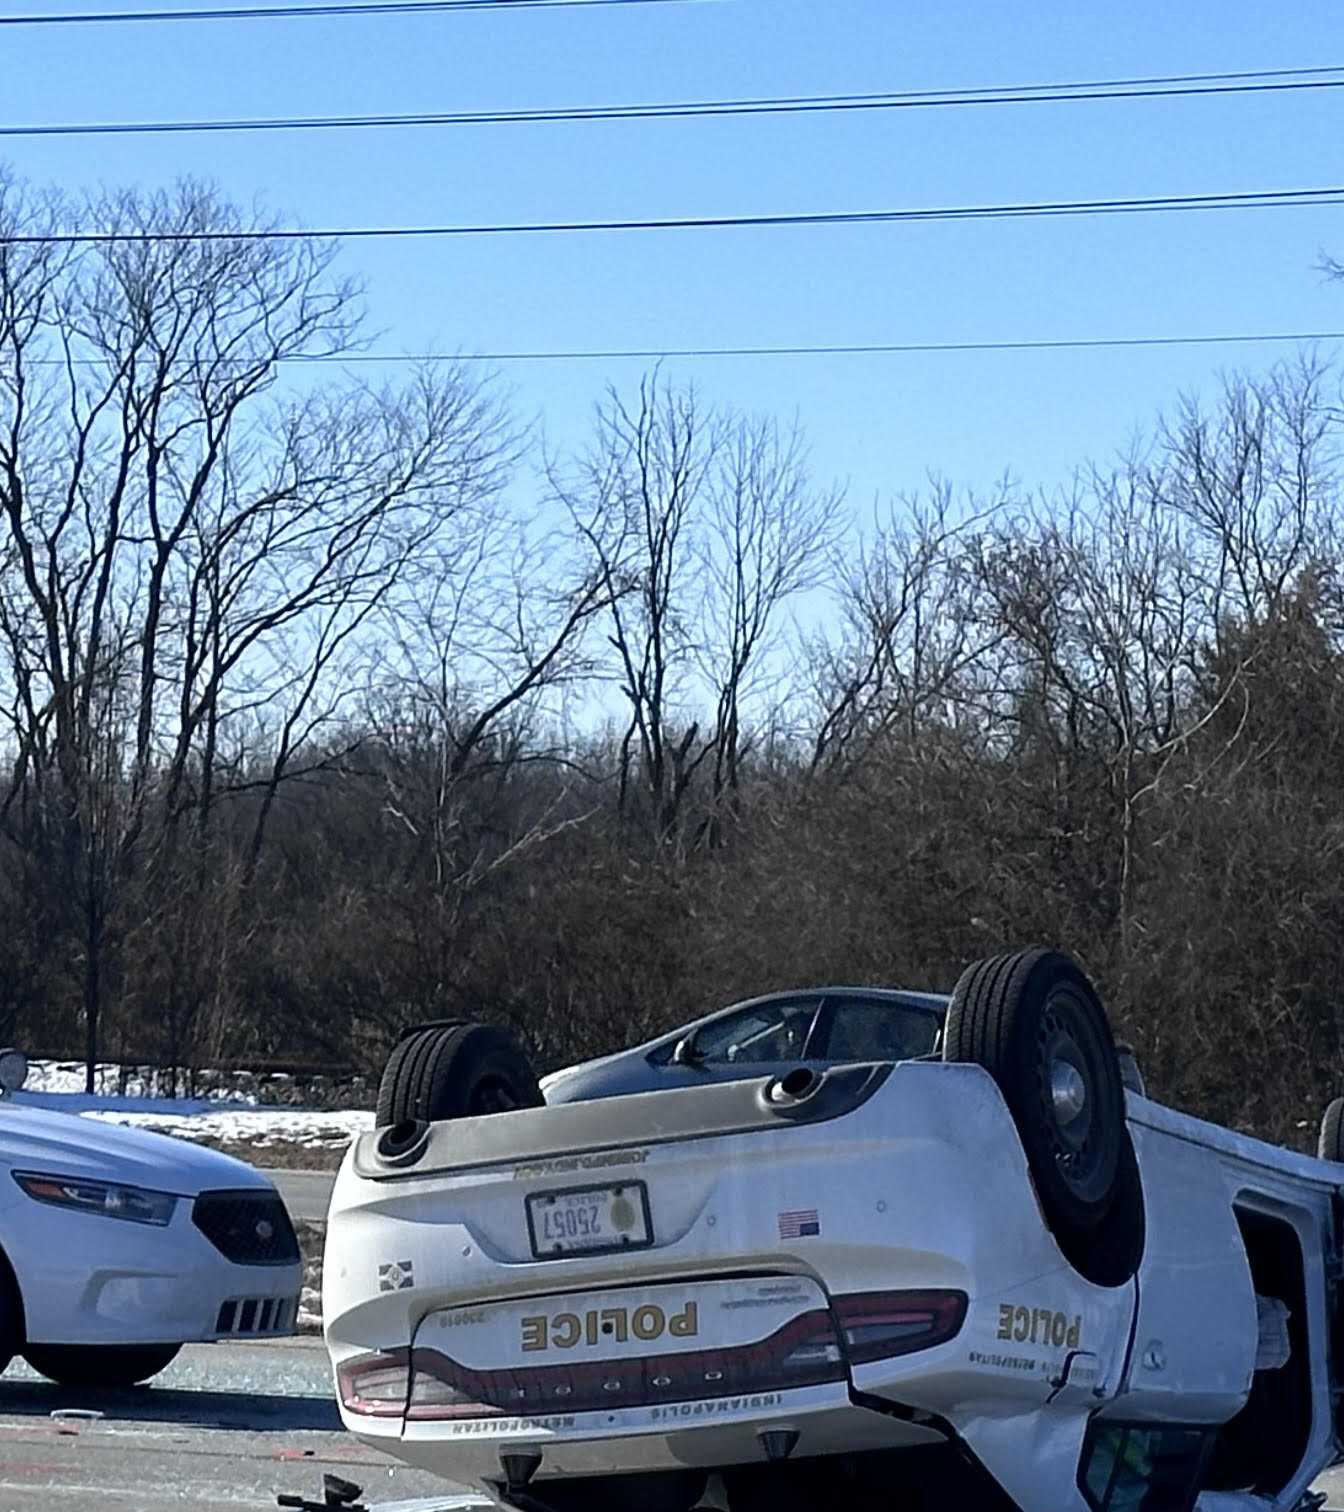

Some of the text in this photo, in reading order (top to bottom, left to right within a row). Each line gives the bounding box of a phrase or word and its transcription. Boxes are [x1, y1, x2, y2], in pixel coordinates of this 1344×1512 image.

[542, 1204, 602, 1241] 25057
[519, 1301, 698, 1352] POLICE
[997, 1303, 1082, 1348] POLICE
[451, 1416, 576, 1434] METROPOLITAN
[649, 1393, 783, 1420] INDIANAPOLIS
